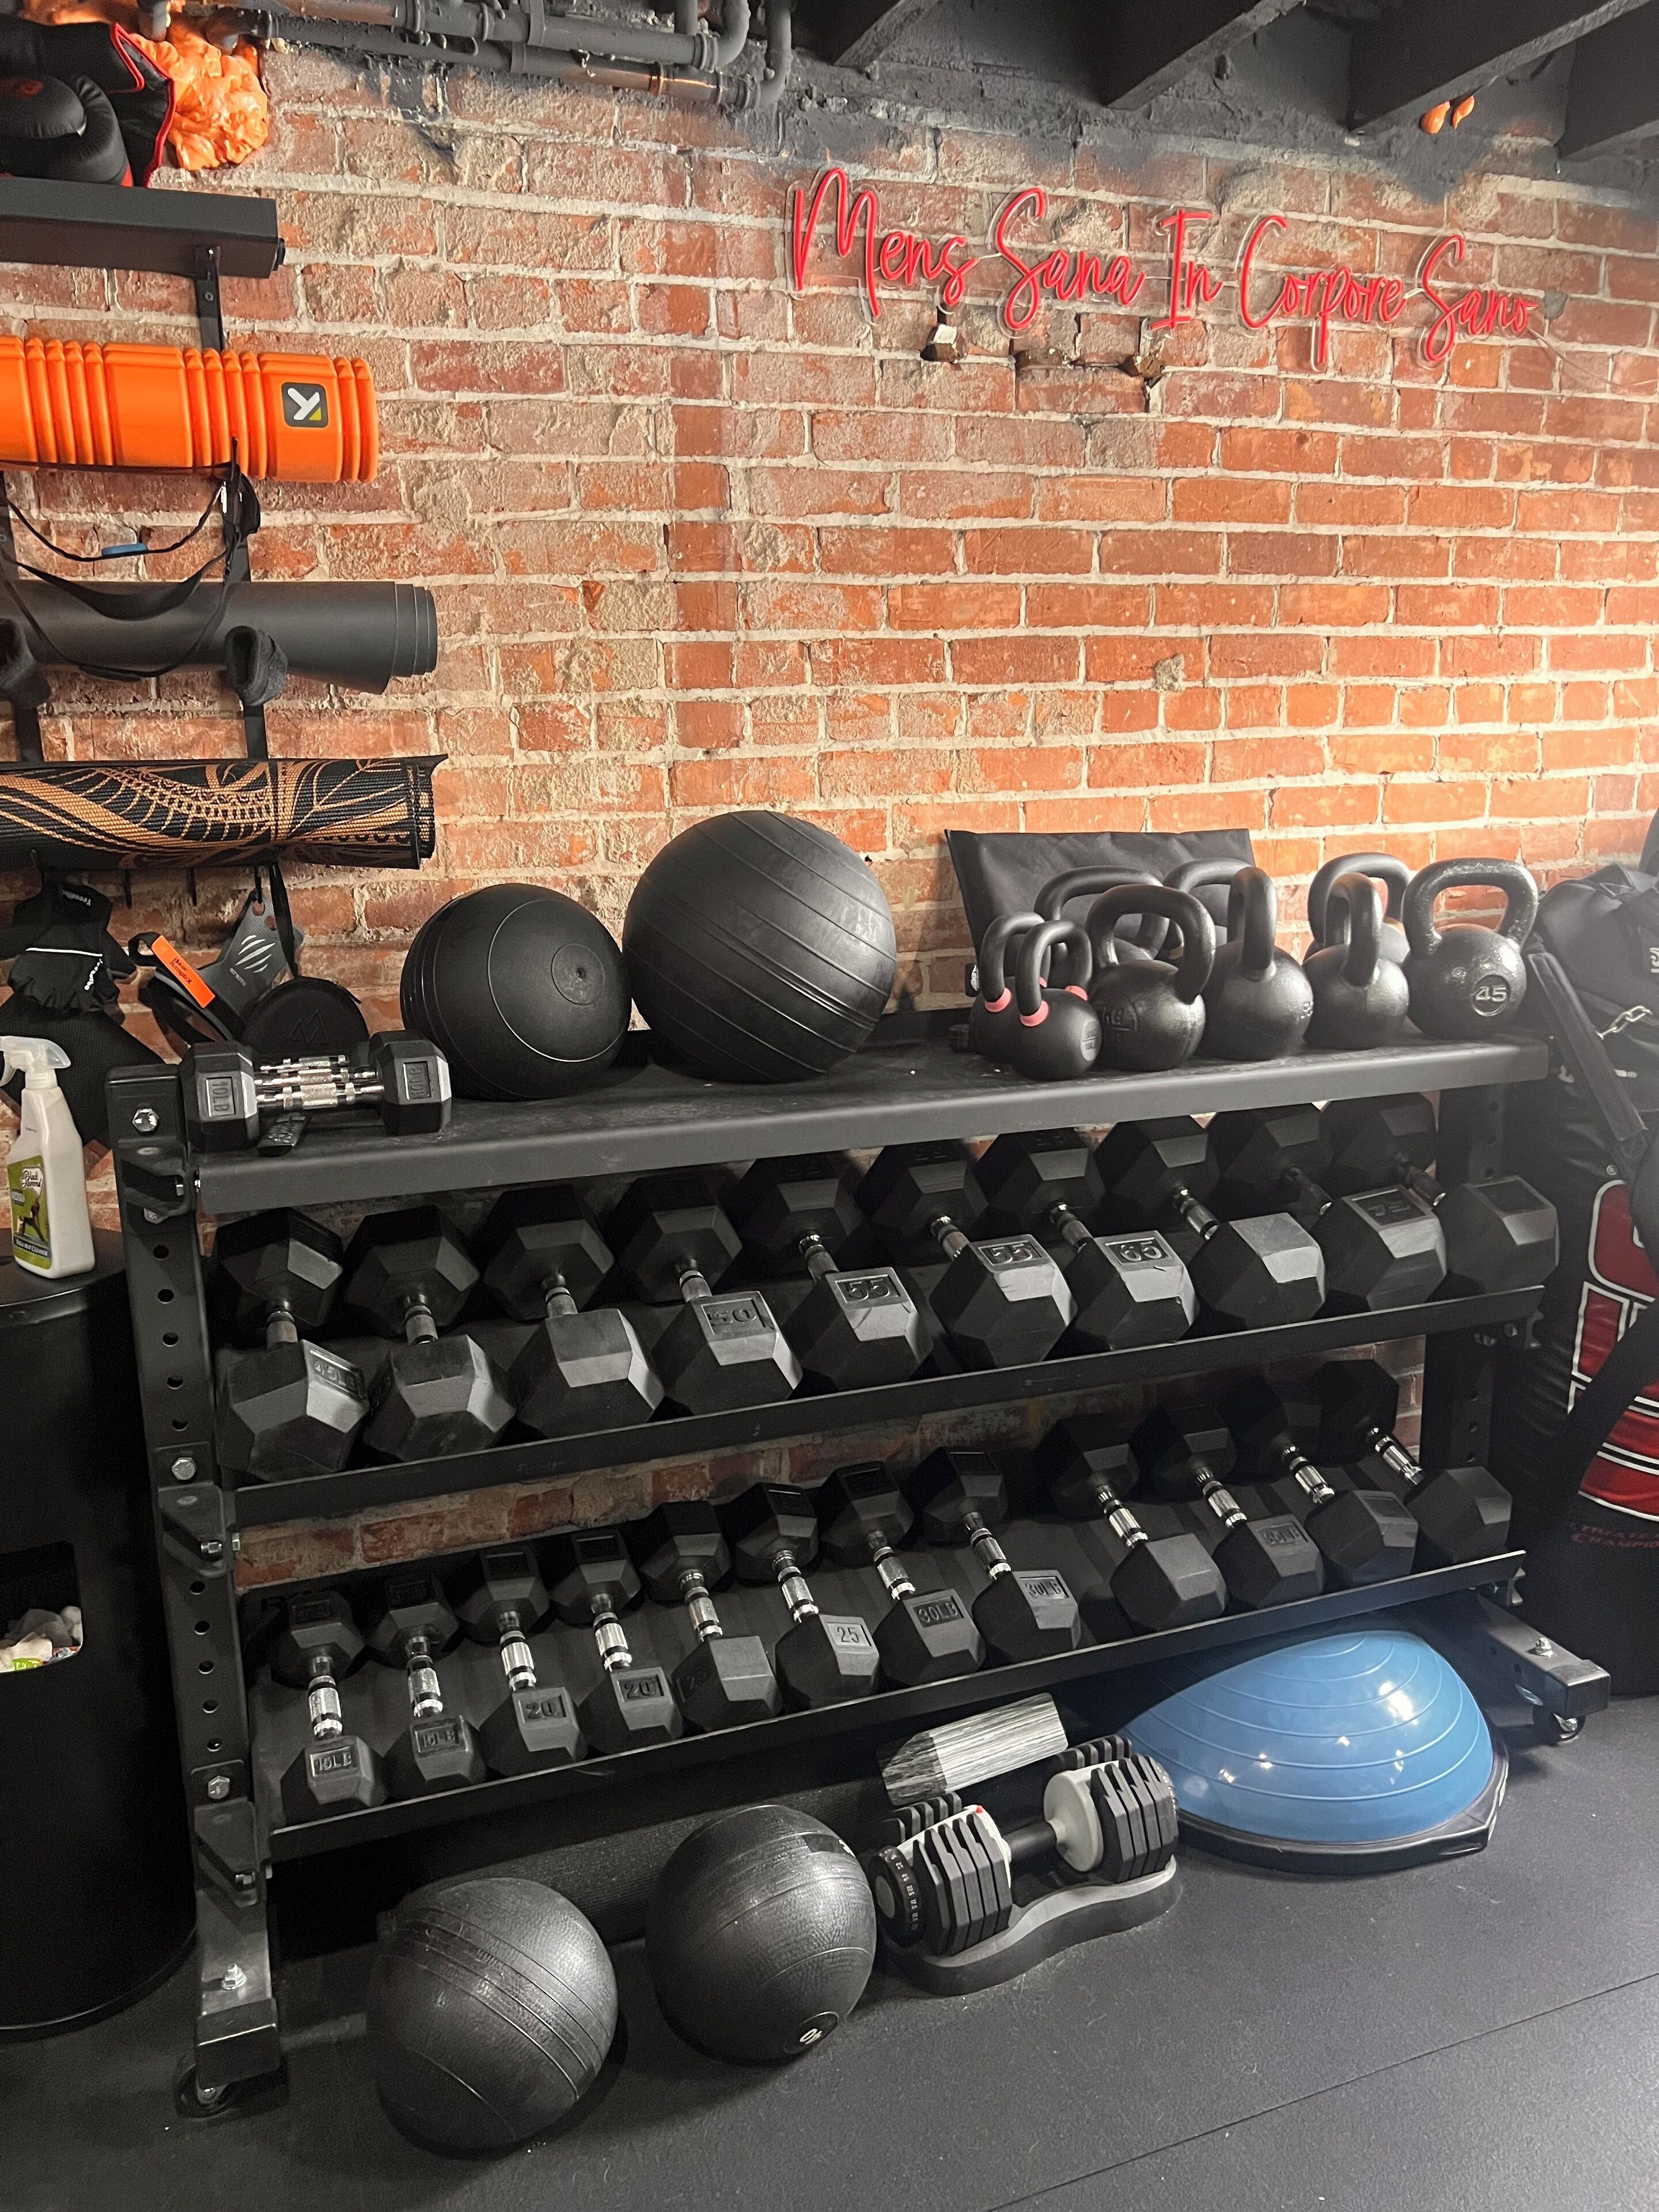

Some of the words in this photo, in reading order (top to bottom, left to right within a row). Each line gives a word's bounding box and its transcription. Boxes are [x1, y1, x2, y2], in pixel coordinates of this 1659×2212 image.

[793, 167, 978, 318] Mens
[998, 188, 1151, 331] Sana
[1150, 209, 1228, 331] In
[1240, 215, 1411, 365] Corpore
[1421, 235, 1536, 363] Sano
[1475, 984, 1507, 1002] 45
[211, 1082, 230, 1112] 10LB
[991, 1243, 1033, 1263] 55
[1119, 1241, 1162, 1262] 65
[843, 1278, 890, 1300] 55
[708, 1308, 756, 1326] 50
[916, 1602, 959, 1623] 30LB
[837, 1626, 859, 1643] 25
[624, 1681, 655, 1699] 20
[526, 1702, 558, 1719] 20
[315, 1752, 352, 1771] 15LB
